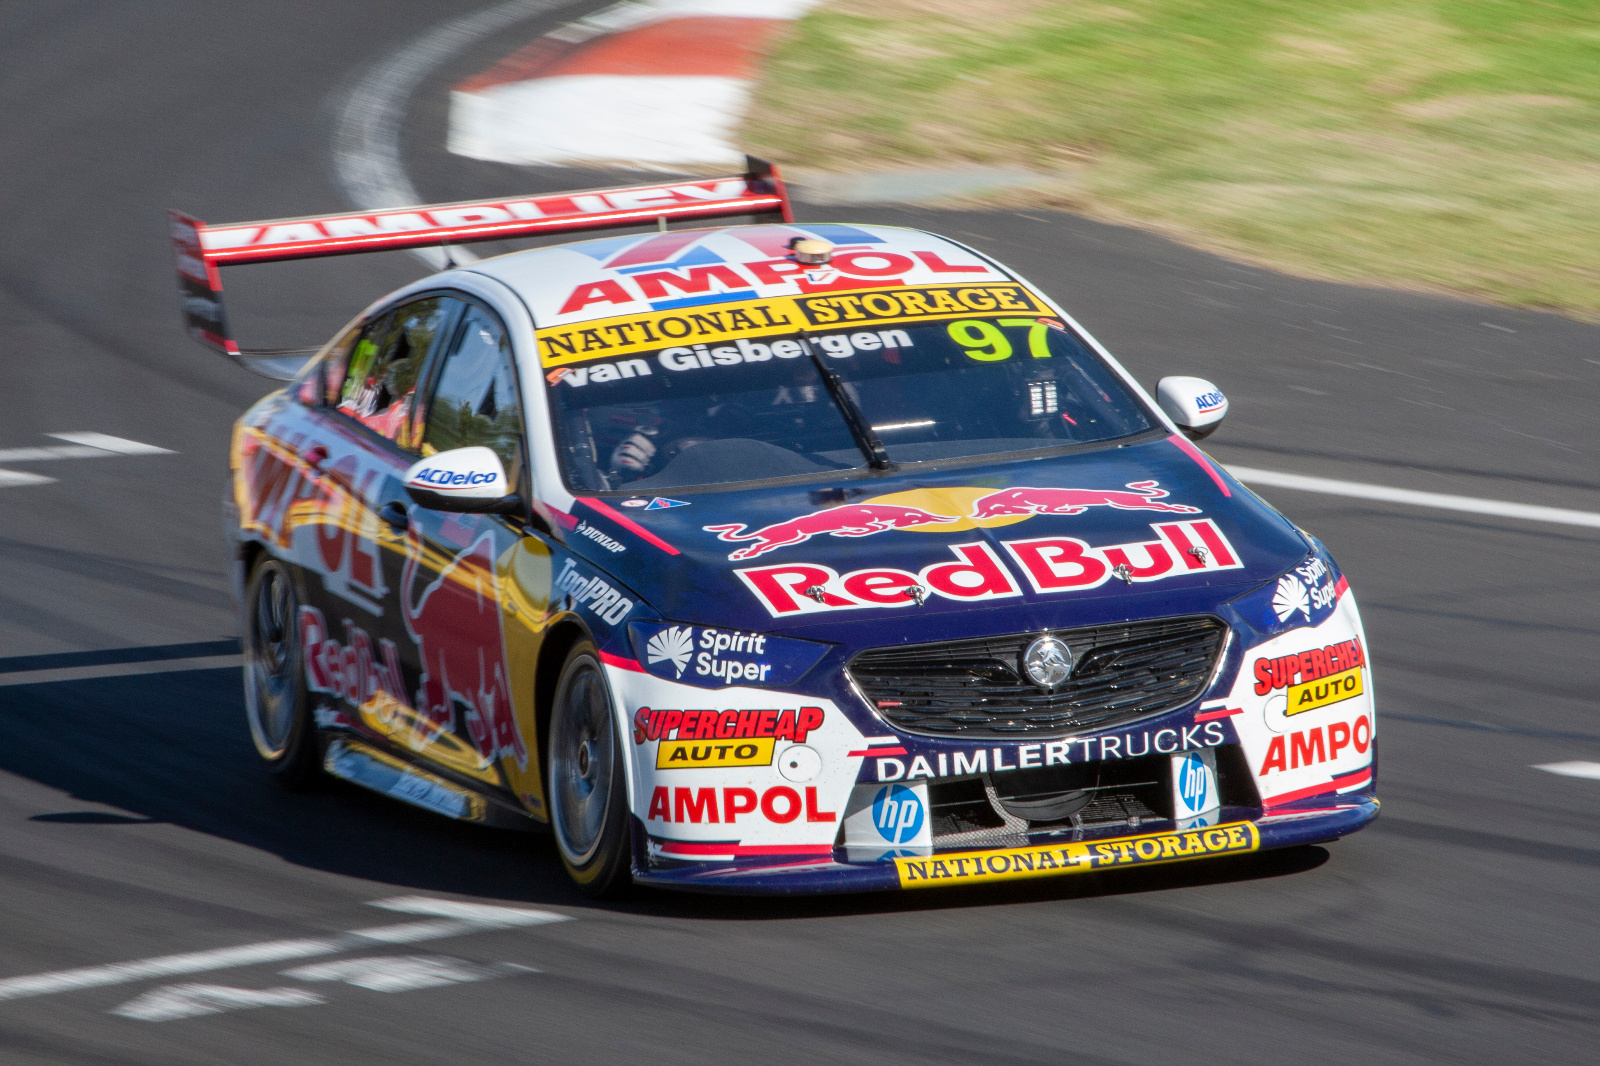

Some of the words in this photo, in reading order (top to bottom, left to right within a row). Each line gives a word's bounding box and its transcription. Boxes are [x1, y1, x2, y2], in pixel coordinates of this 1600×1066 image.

[558, 251, 989, 315] AMPOL
[542, 304, 790, 358] NATIONAL
[808, 288, 1029, 322] STORAGE
[947, 318, 1053, 361] 97
[562, 357, 652, 387] van
[659, 330, 913, 372] Gisbergen
[414, 467, 498, 486] ACDelco
[582, 526, 626, 553] DUNLOP
[740, 542, 1018, 614] Red
[1009, 522, 1240, 590] Bull
[1296, 558, 1327, 587] Spirit
[554, 557, 633, 626] ToolPRO
[1311, 580, 1336, 609] Super
[701, 629, 766, 655] Spirit
[696, 653, 771, 683] Super
[1298, 675, 1356, 706] AUTO
[634, 706, 824, 744] SUPERCHEAP
[1259, 714, 1371, 776] AMPO
[669, 744, 758, 761] AUTO
[879, 745, 1070, 781] DAIMLER
[1077, 722, 1223, 761] TRUCKS
[1184, 753, 1205, 812] hp
[648, 785, 837, 824] AMPOL
[879, 784, 918, 844] hp
[906, 850, 1080, 880] NATIONAL
[1099, 827, 1246, 866] STORAGE
